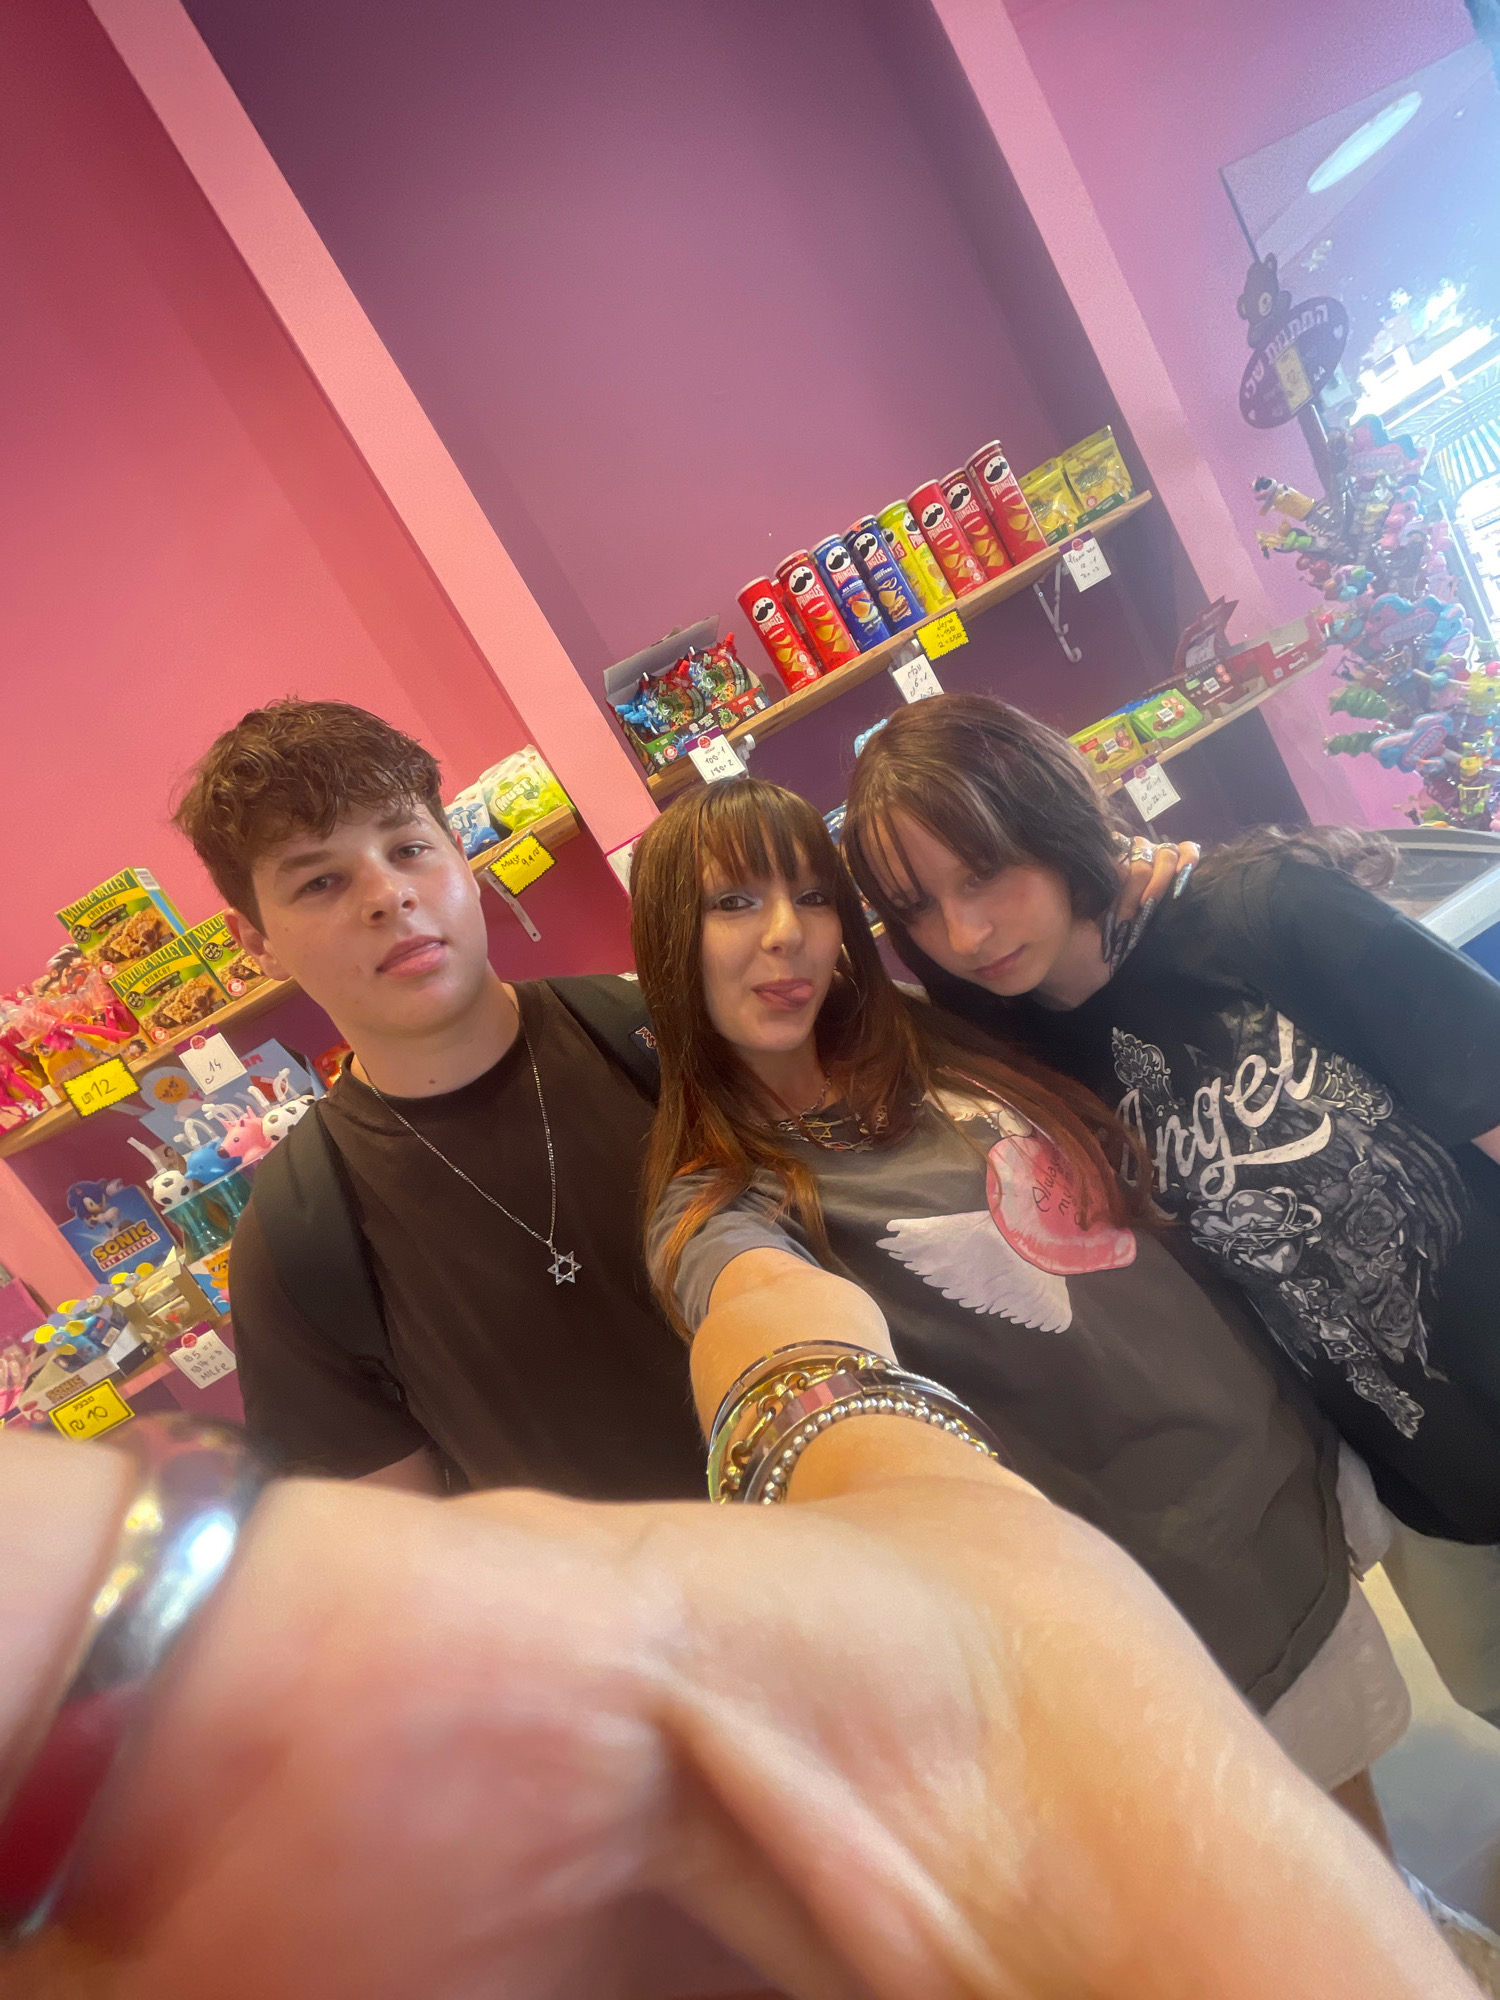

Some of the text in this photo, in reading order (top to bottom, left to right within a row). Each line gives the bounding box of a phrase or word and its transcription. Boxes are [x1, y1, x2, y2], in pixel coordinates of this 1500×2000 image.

[927, 517, 953, 542] PRINGLES
[795, 584, 824, 610] PRINGLES
[759, 612, 784, 636] PRINGLES
[495, 777, 533, 812] MUST
[501, 854, 521, 871] Must
[61, 889, 95, 925] NATURE
[93, 873, 130, 899] VALLEY
[87, 898, 117, 920] CRUNCHY
[116, 960, 150, 992] NATURE
[148, 942, 183, 967] VALLEY
[142, 965, 171, 987] CRUNCHY
[93, 1220, 152, 1263] SONIC
[73, 1396, 95, 1412] מבצע
[87, 1405, 108, 1421] 10
